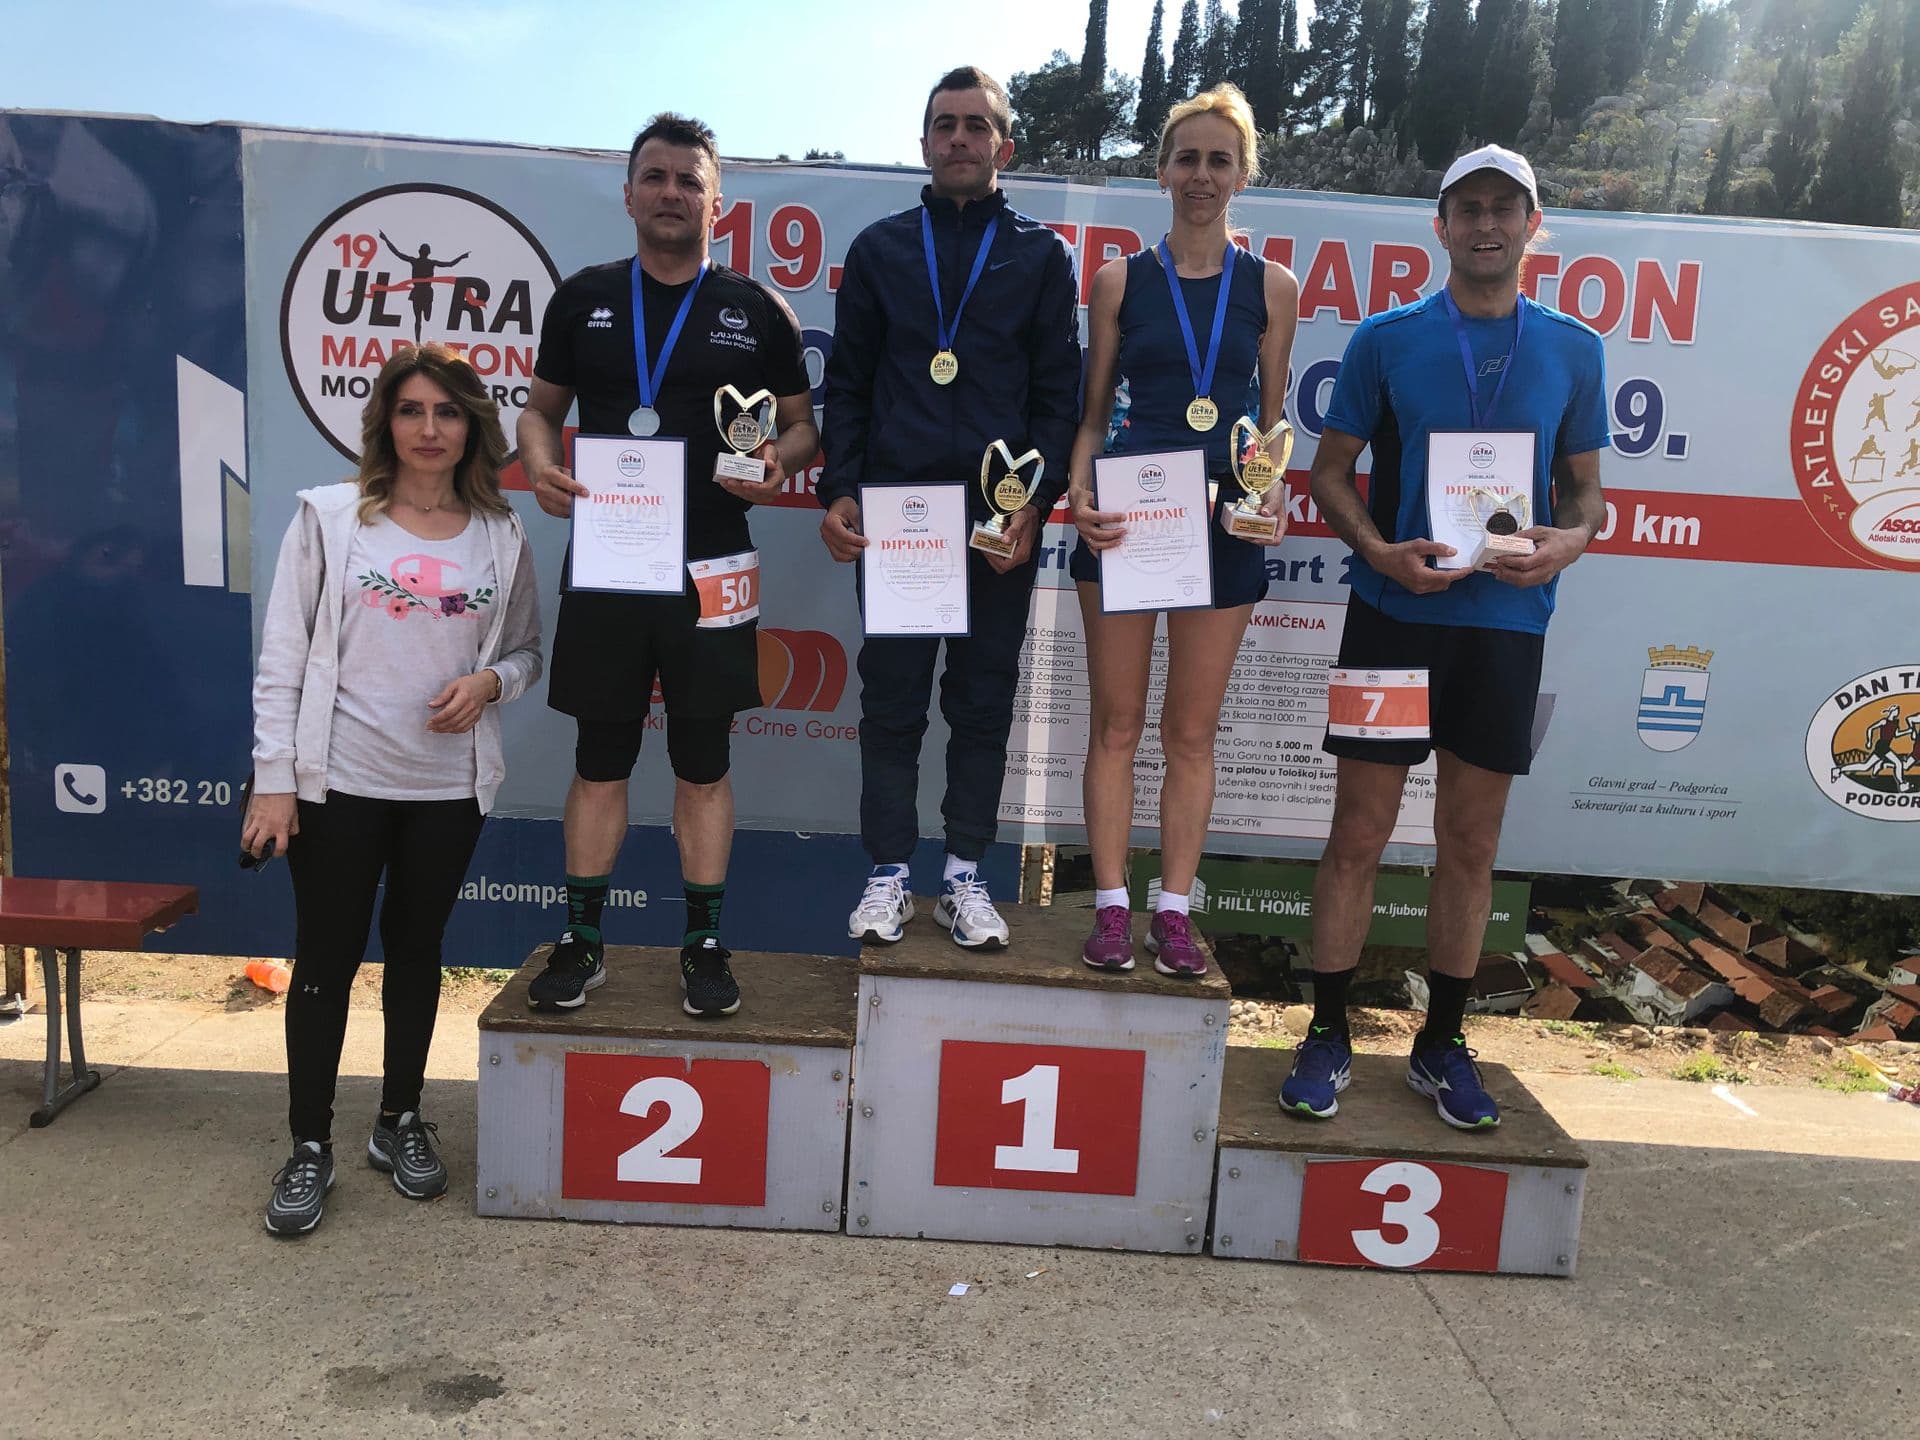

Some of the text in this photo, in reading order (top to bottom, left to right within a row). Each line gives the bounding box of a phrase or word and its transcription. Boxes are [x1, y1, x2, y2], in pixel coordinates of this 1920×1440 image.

[333, 233, 378, 268] 19
[713, 201, 845, 289] 19.
[322, 269, 534, 335] ULTRA
[1803, 327, 1869, 489] ATLETSKI
[592, 493, 665, 506] DIPLOMU
[1127, 507, 1188, 522] IPLOMU
[1632, 504, 1701, 546] km
[880, 538, 949, 551] DIPLOMU
[721, 575, 751, 611] 50
[1040, 628, 1076, 639] časova
[1039, 642, 1075, 653] časova
[1037, 656, 1073, 668] časova
[1255, 653, 1268, 663] do
[1270, 654, 1310, 667] četvrtog
[1036, 671, 1072, 683] časova
[1244, 668, 1257, 677] do
[1259, 668, 1300, 681] devetog
[1035, 685, 1071, 696] časova
[1242, 682, 1256, 691] do
[1258, 683, 1299, 695] devetog
[1834, 675, 1890, 711] DAN
[1034, 700, 1070, 711] časova
[1235, 696, 1260, 707] škola
[1261, 700, 1275, 708] na
[1277, 699, 1296, 709] 800
[1362, 692, 1385, 723] 7
[1033, 714, 1069, 725] časova
[1232, 710, 1257, 720] škola
[1296, 715, 1307, 723] m
[746, 716, 798, 738] Crne
[805, 720, 857, 741] Gore
[1233, 738, 1257, 748] Goru
[1259, 741, 1273, 749] na
[1275, 740, 1301, 751] 5.000
[1303, 743, 1314, 751] m
[1030, 754, 1067, 766] časova
[1237, 750, 1261, 761] Goru
[1263, 754, 1277, 762] na
[1279, 753, 1311, 764] 10.000
[1312, 756, 1323, 764] m
[1221, 766, 1234, 774] na
[1236, 765, 1267, 777] platou
[1269, 768, 1276, 776] u
[1278, 767, 1318, 781] Tološkoj
[120, 778, 190, 804] +382
[197, 781, 232, 807] 20
[1259, 780, 1302, 791] osnovnih
[1588, 776, 1627, 791] Glavni
[1628, 779, 1656, 793] grad
[1669, 780, 1728, 798] Podgorica
[1261, 791, 1281, 802] kao
[1286, 794, 1333, 806] discipline
[1027, 807, 1063, 818] časova
[1571, 798, 1637, 815] Sekretarijat
[1640, 804, 1653, 815] za
[1655, 803, 1698, 818] kulturu
[1706, 808, 1738, 821] sport
[1241, 887, 1301, 901] LJUBOVIĆ
[1218, 896, 1255, 912] HILL
[1260, 898, 1313, 917] HOME
[994, 1063, 1080, 1175] 1
[616, 1075, 704, 1185] 2
[1351, 1160, 1444, 1270] 3
